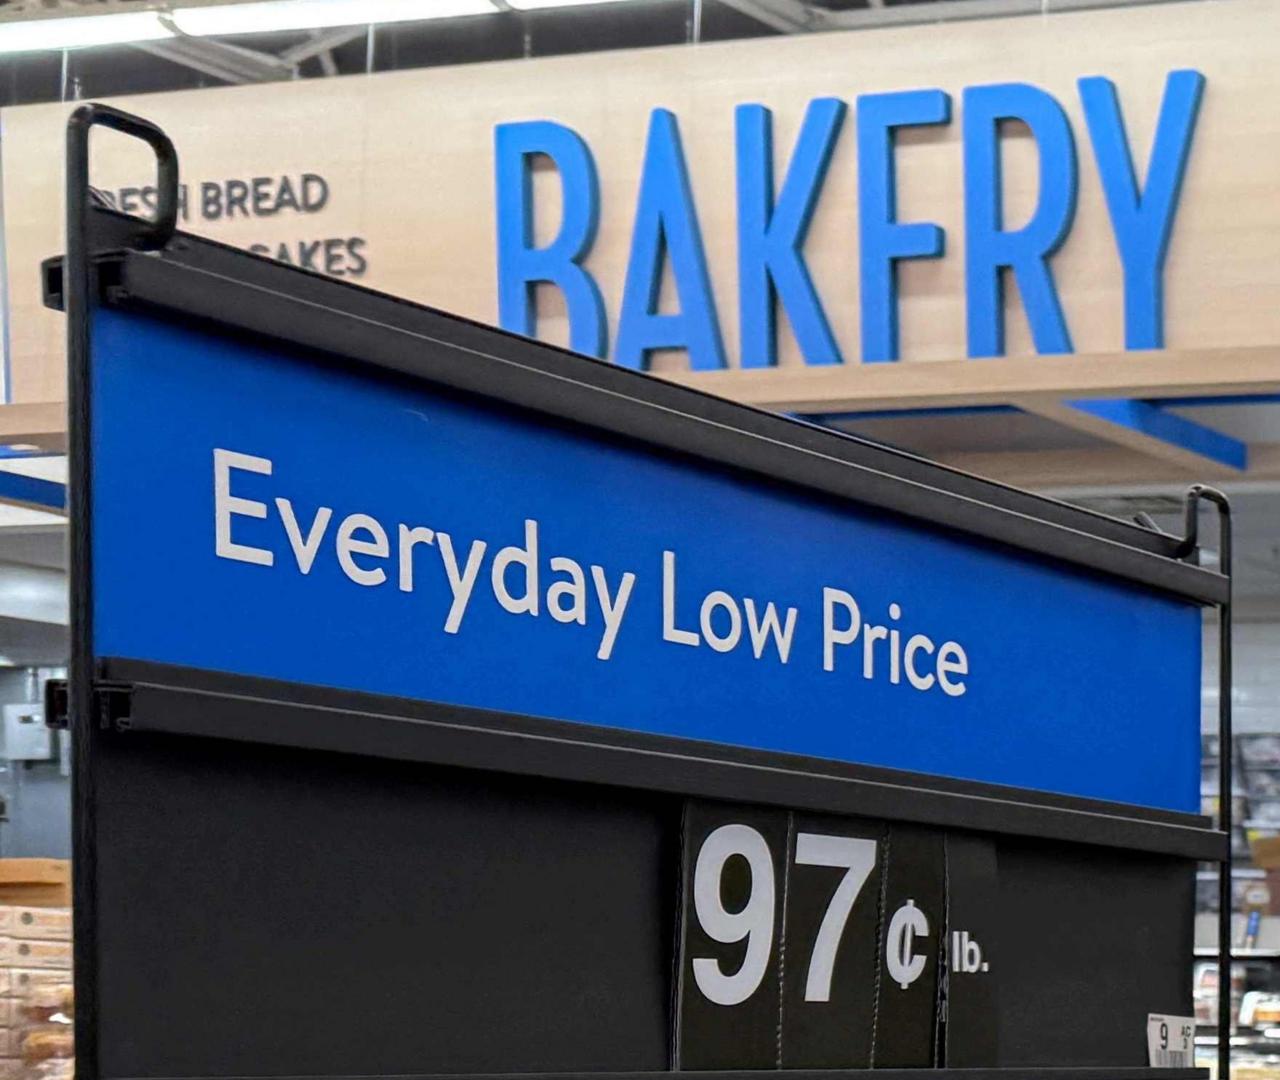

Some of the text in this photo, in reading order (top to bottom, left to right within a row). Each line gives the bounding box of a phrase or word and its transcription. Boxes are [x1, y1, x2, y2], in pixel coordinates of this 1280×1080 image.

[201, 173, 329, 220] BREAD
[494, 69, 1206, 372] BAKERY
[213, 447, 969, 697] Everyday Low Price
[951, 930, 990, 973] lb.
